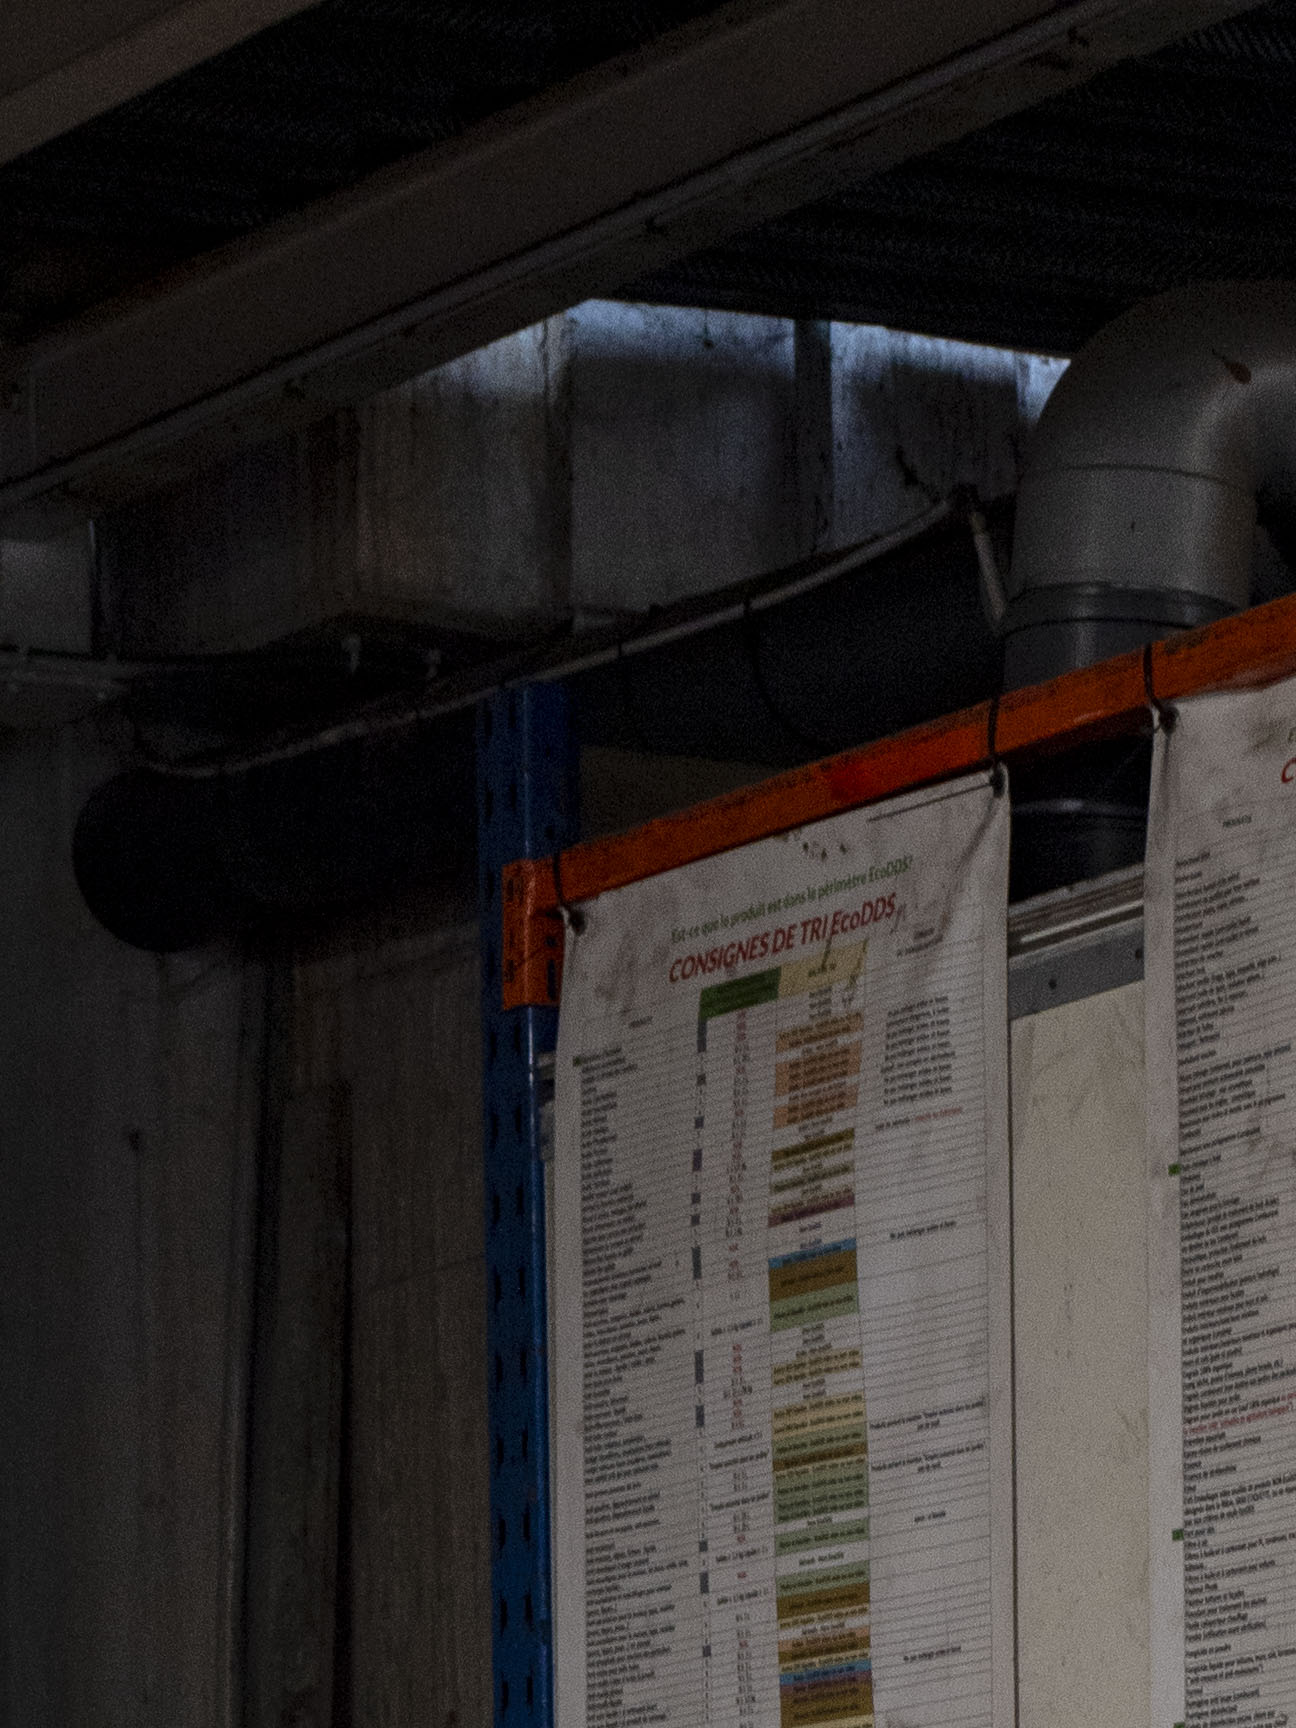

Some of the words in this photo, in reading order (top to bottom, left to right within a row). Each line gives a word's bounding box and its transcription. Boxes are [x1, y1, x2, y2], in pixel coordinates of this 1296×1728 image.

[669, 932, 768, 983] CONSIGNES
[771, 924, 796, 954] DE
[801, 914, 827, 943] TRI
[830, 894, 894, 935] EcoDDS
